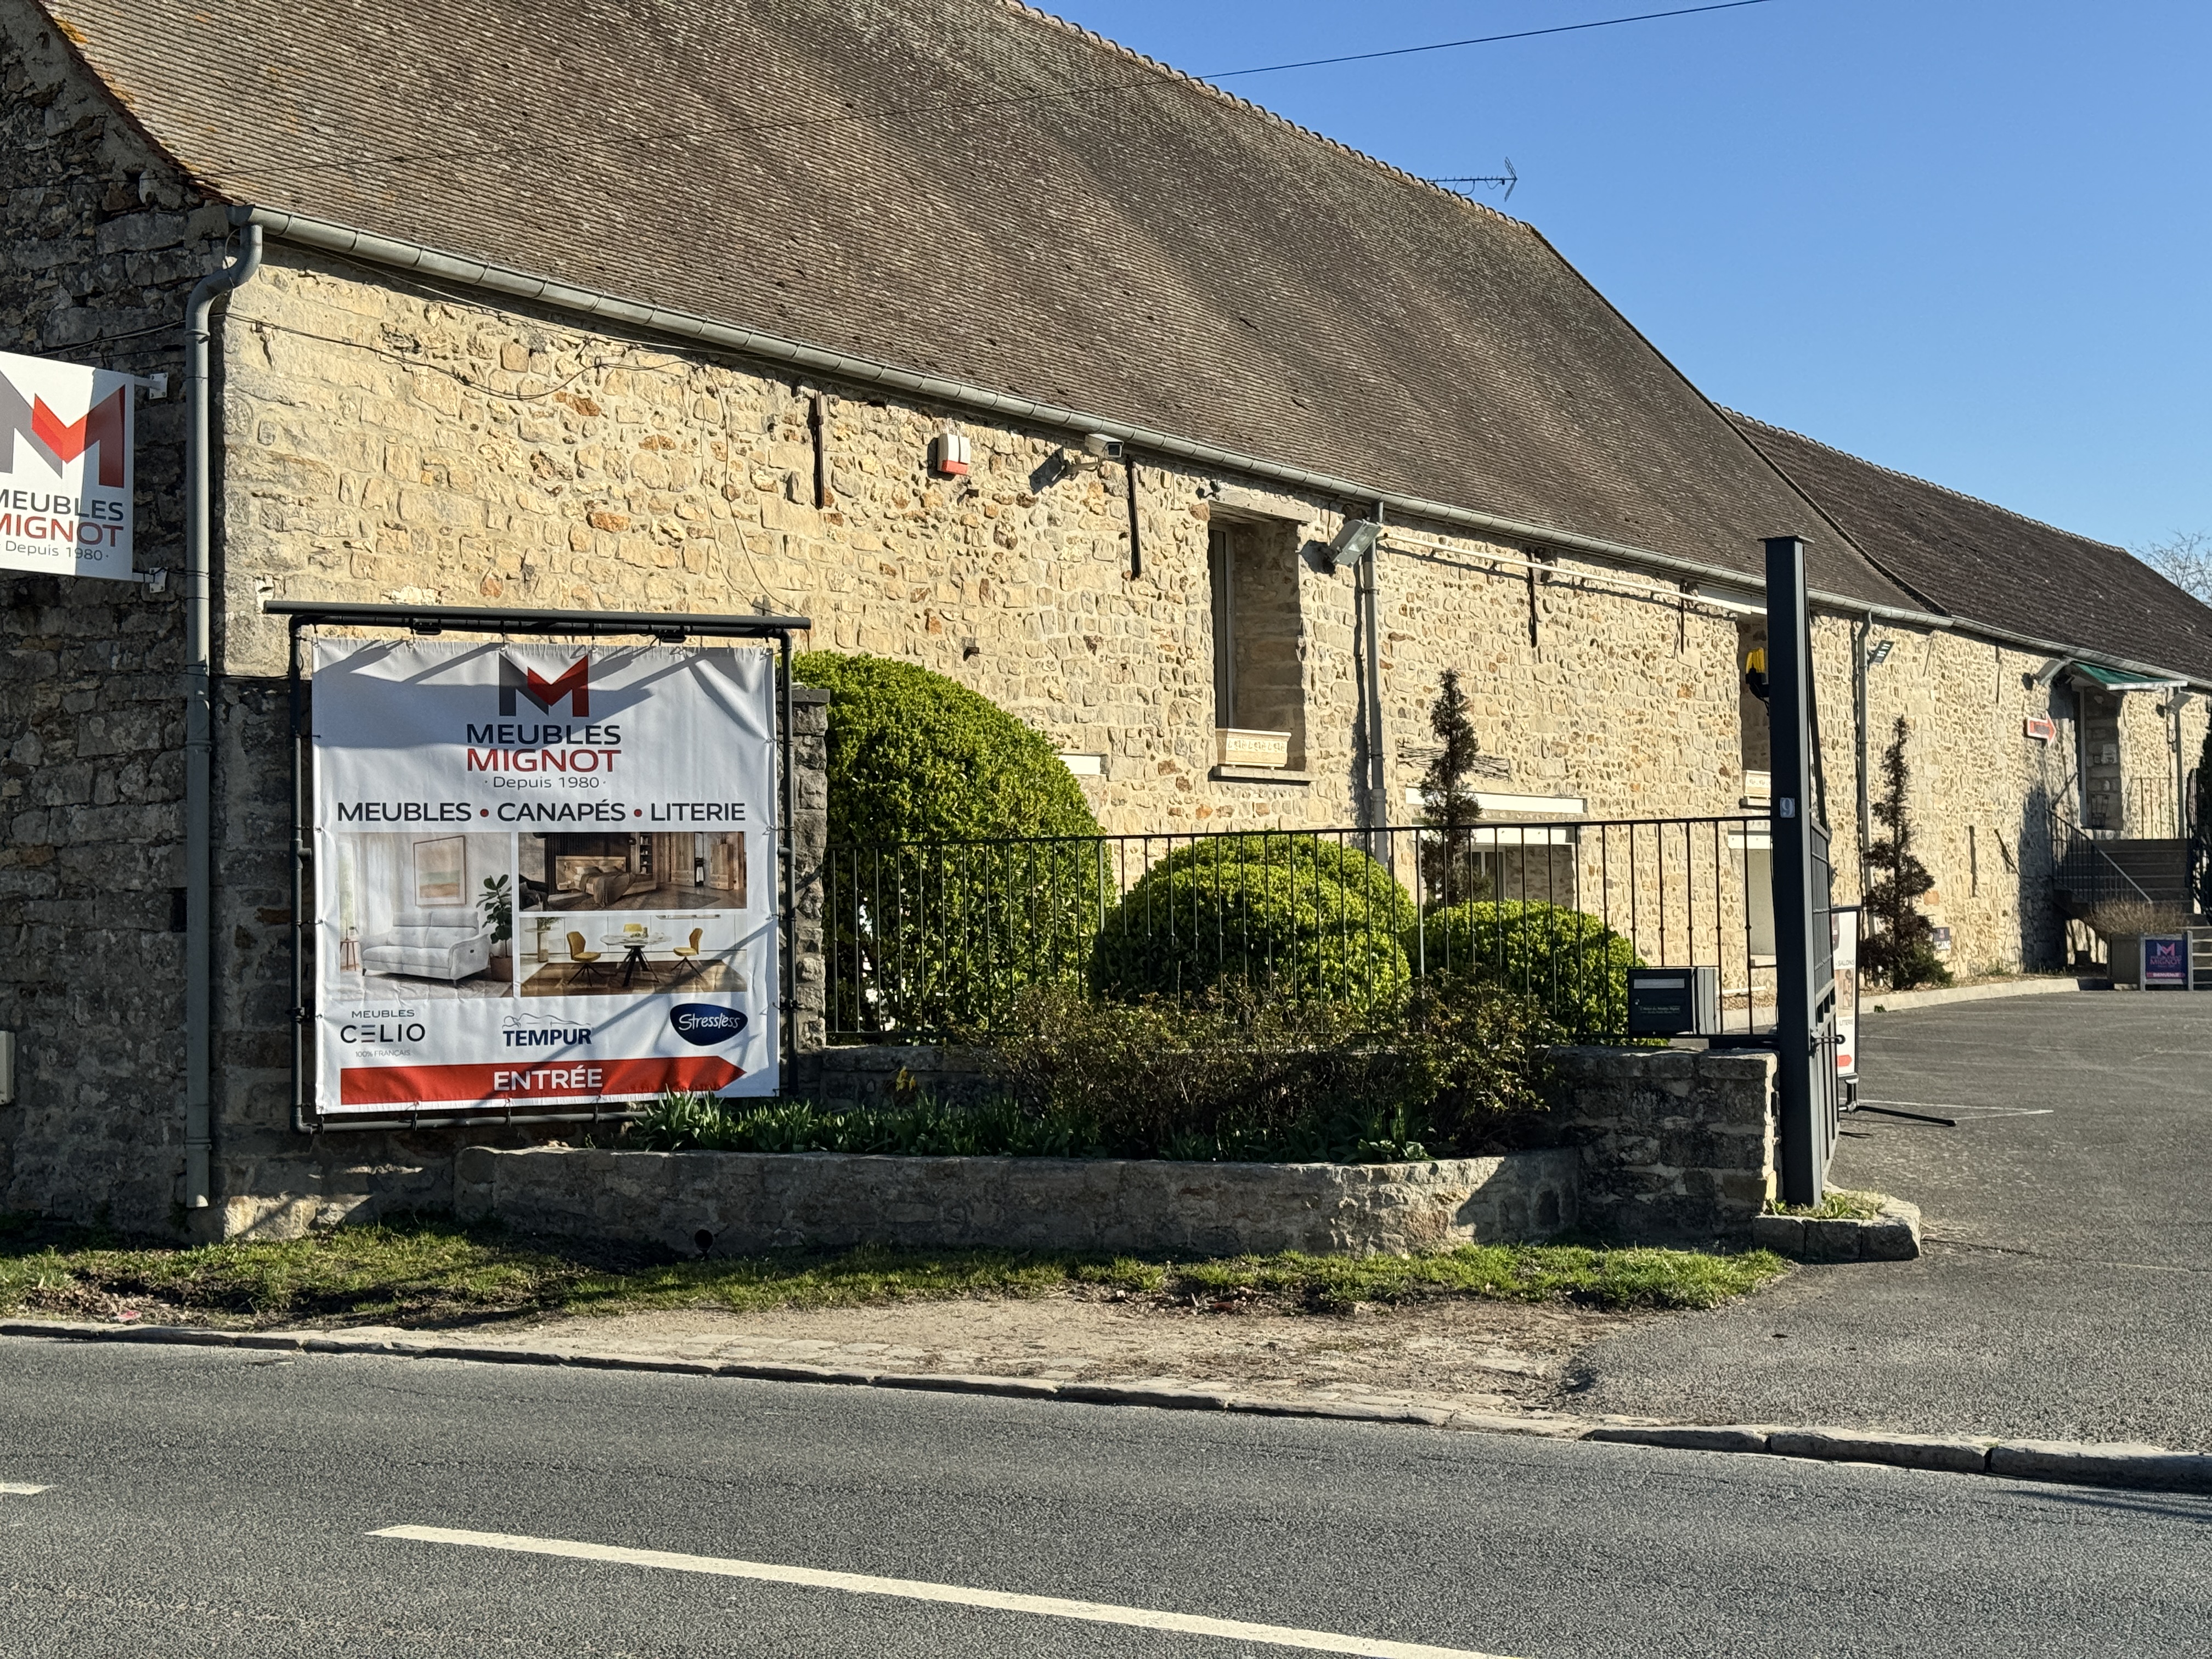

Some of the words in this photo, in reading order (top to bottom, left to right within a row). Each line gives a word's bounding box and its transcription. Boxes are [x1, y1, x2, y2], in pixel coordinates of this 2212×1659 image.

[5, 540, 59, 557] Depuis
[66, 547, 103, 561] 1980
[466, 724, 622, 745] MEUBLES
[467, 748, 622, 772] MIGNOT
[493, 776, 552, 791] Depuis
[558, 777, 599, 788] 1980
[337, 802, 472, 822] MEUBLES
[497, 799, 626, 822] CANAPÉS
[651, 803, 746, 821] LITERIE
[1781, 798, 1793, 817] 9
[352, 1009, 415, 1018] MEUBLES
[678, 1012, 741, 1031] Stressless
[340, 1023, 426, 1044] CELIO
[503, 1028, 592, 1047] TEMPUR
[374, 1049, 411, 1057] FRANÇAIS
[494, 1064, 603, 1091] ENTRÉE
